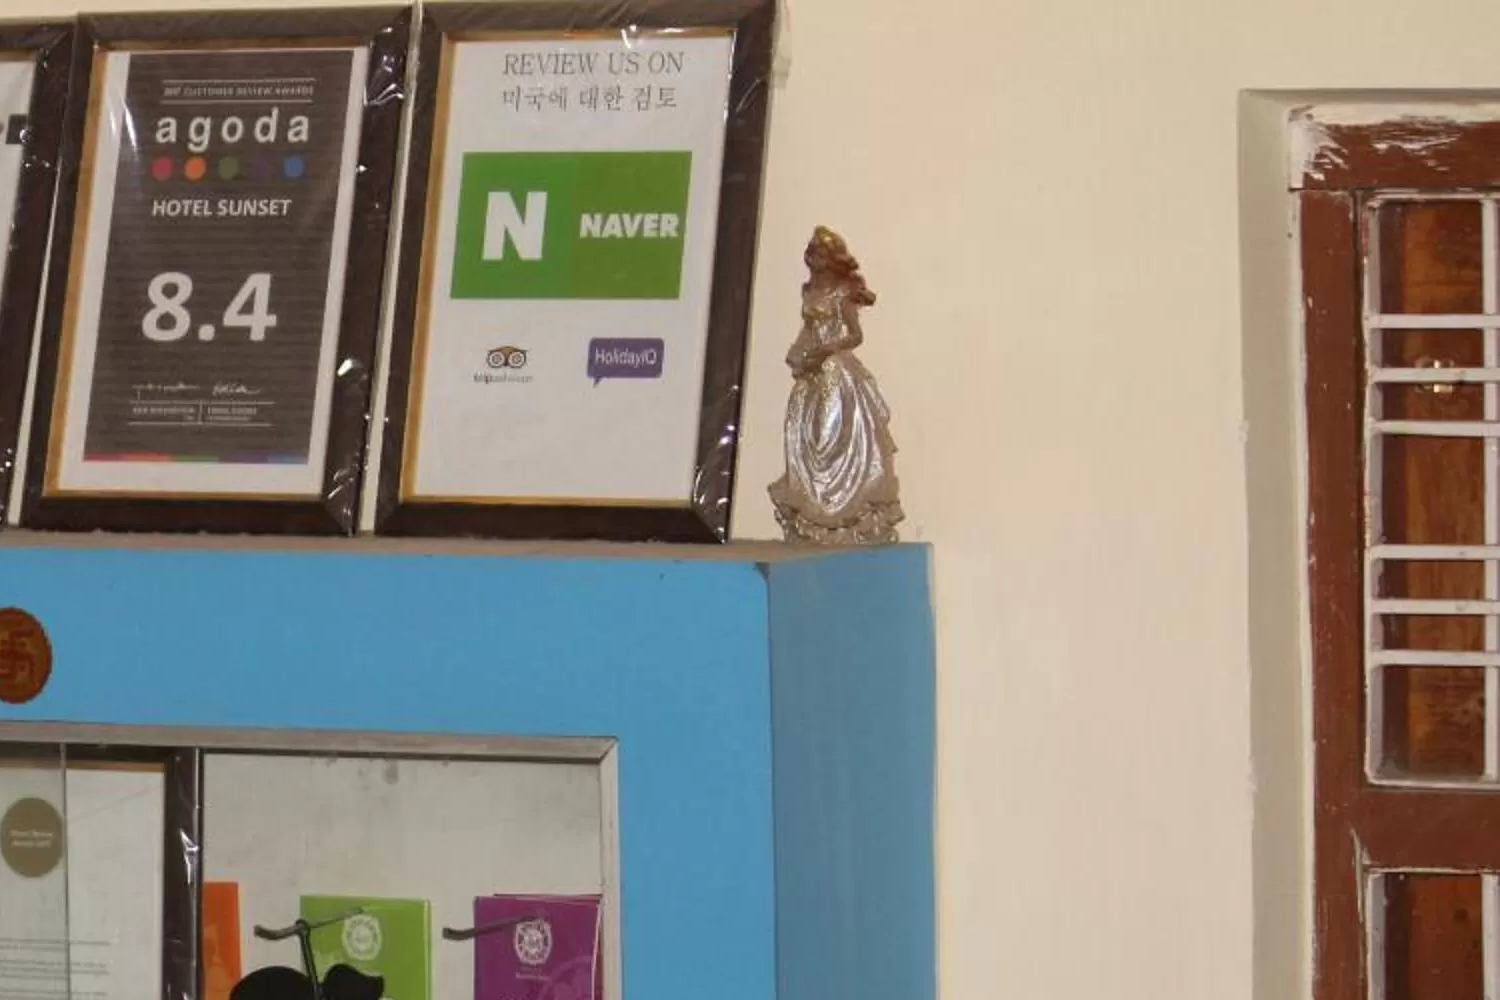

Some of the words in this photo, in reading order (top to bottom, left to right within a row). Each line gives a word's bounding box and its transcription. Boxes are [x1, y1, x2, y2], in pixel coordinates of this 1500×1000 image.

[503, 51, 599, 76] REVIEW
[608, 51, 640, 75] US
[648, 50, 685, 75] ON
[503, 84, 567, 112] 미국에
[579, 84, 624, 112] 대한
[633, 84, 678, 112] 검토
[155, 106, 310, 153] agoda
[152, 199, 213, 217] HOTEL
[217, 198, 293, 217] SUNSET
[481, 190, 549, 262] N
[579, 212, 680, 239] NAVER
[141, 271, 278, 342] 8.4
